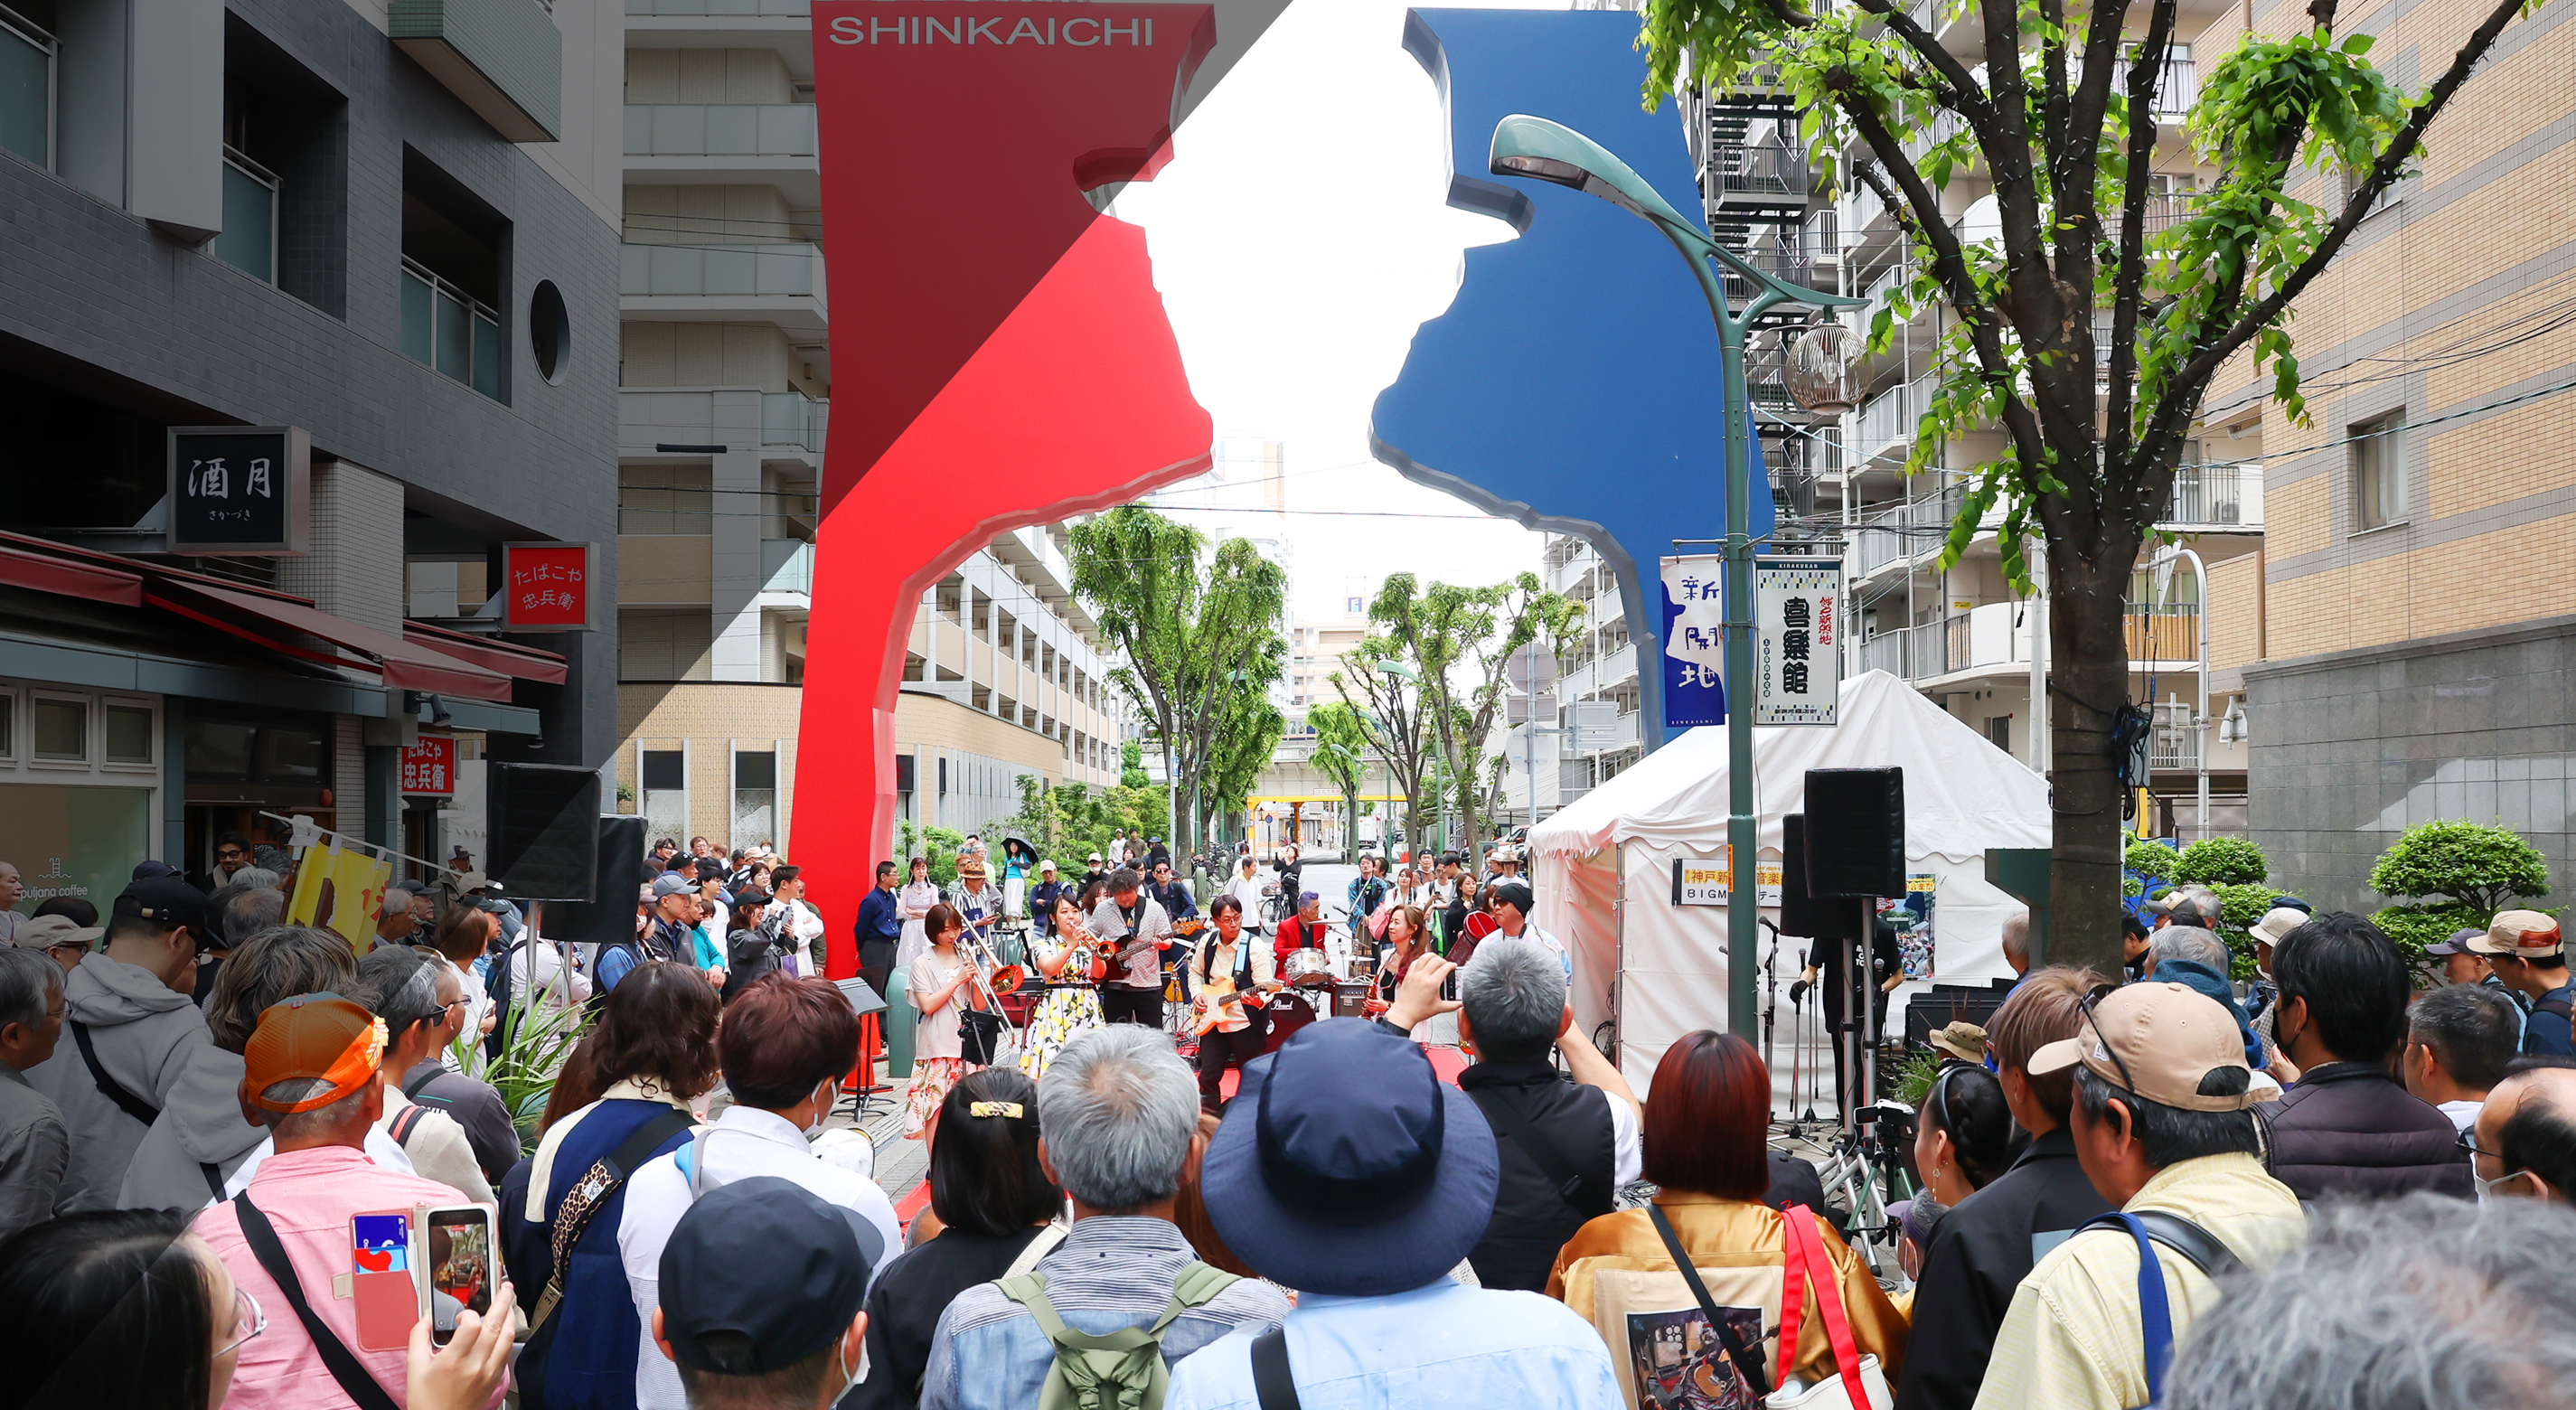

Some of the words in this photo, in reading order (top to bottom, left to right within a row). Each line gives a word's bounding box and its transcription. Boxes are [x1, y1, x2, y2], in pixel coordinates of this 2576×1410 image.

[829, 16, 1152, 46] SHINKAICHI
[187, 457, 271, 500] 酒月
[209, 509, 251, 522] さかづき
[514, 562, 582, 586] たばこや
[522, 589, 577, 611] 忠兵衛
[1678, 575, 1720, 689] 新開地
[403, 761, 446, 791] 忠兵衛
[1756, 871, 1783, 886] 音楽
[59, 884, 89, 897] coffee
[1687, 888, 1727, 898] BIGM
[1271, 999, 1293, 1010] Pearl
